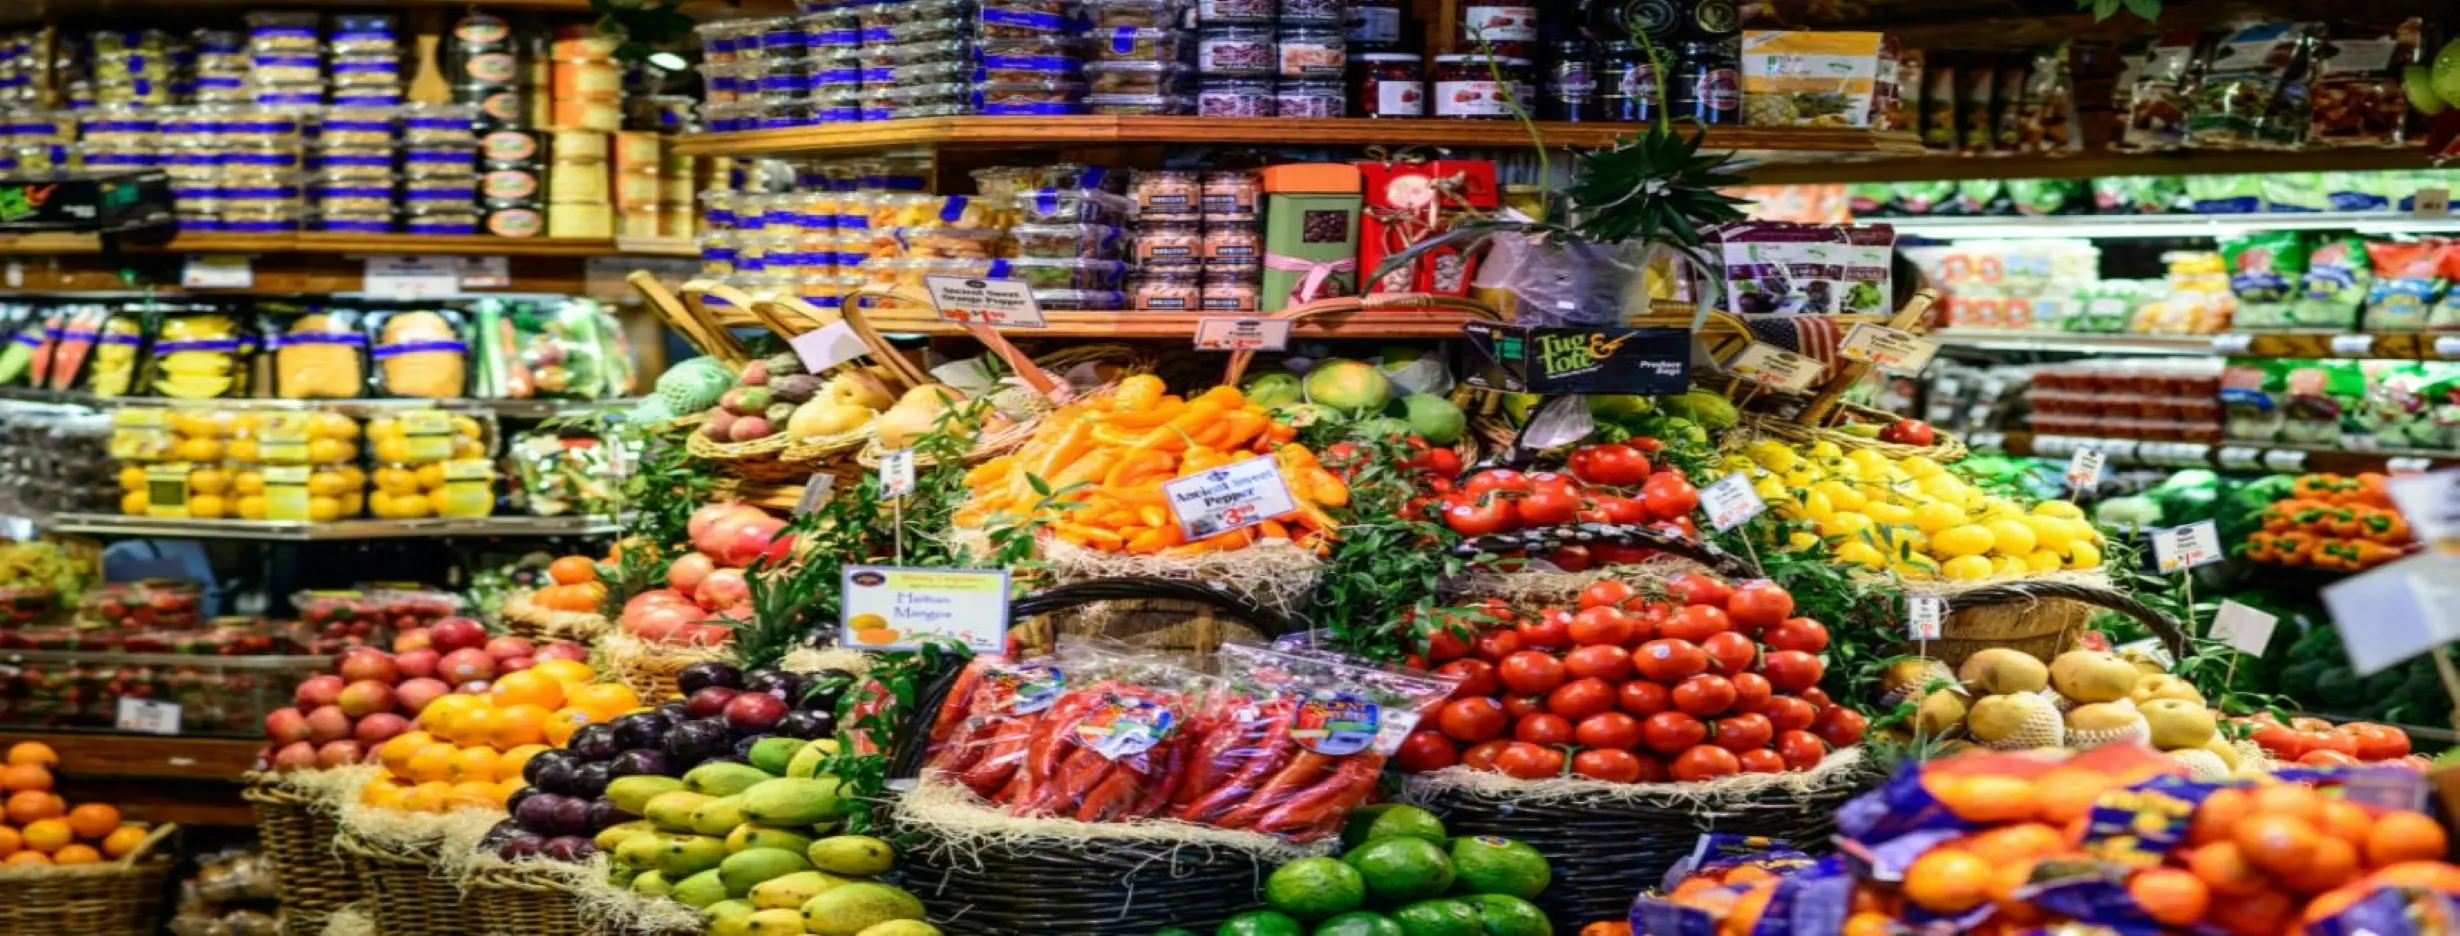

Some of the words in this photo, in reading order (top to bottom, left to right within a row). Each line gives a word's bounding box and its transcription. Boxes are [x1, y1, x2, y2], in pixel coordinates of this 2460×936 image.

[985, 296, 1025, 306] Pepper
[1535, 333, 1587, 358] Tug
[1177, 482, 1230, 502] Ancient
[1204, 487, 1254, 507] Pepper
